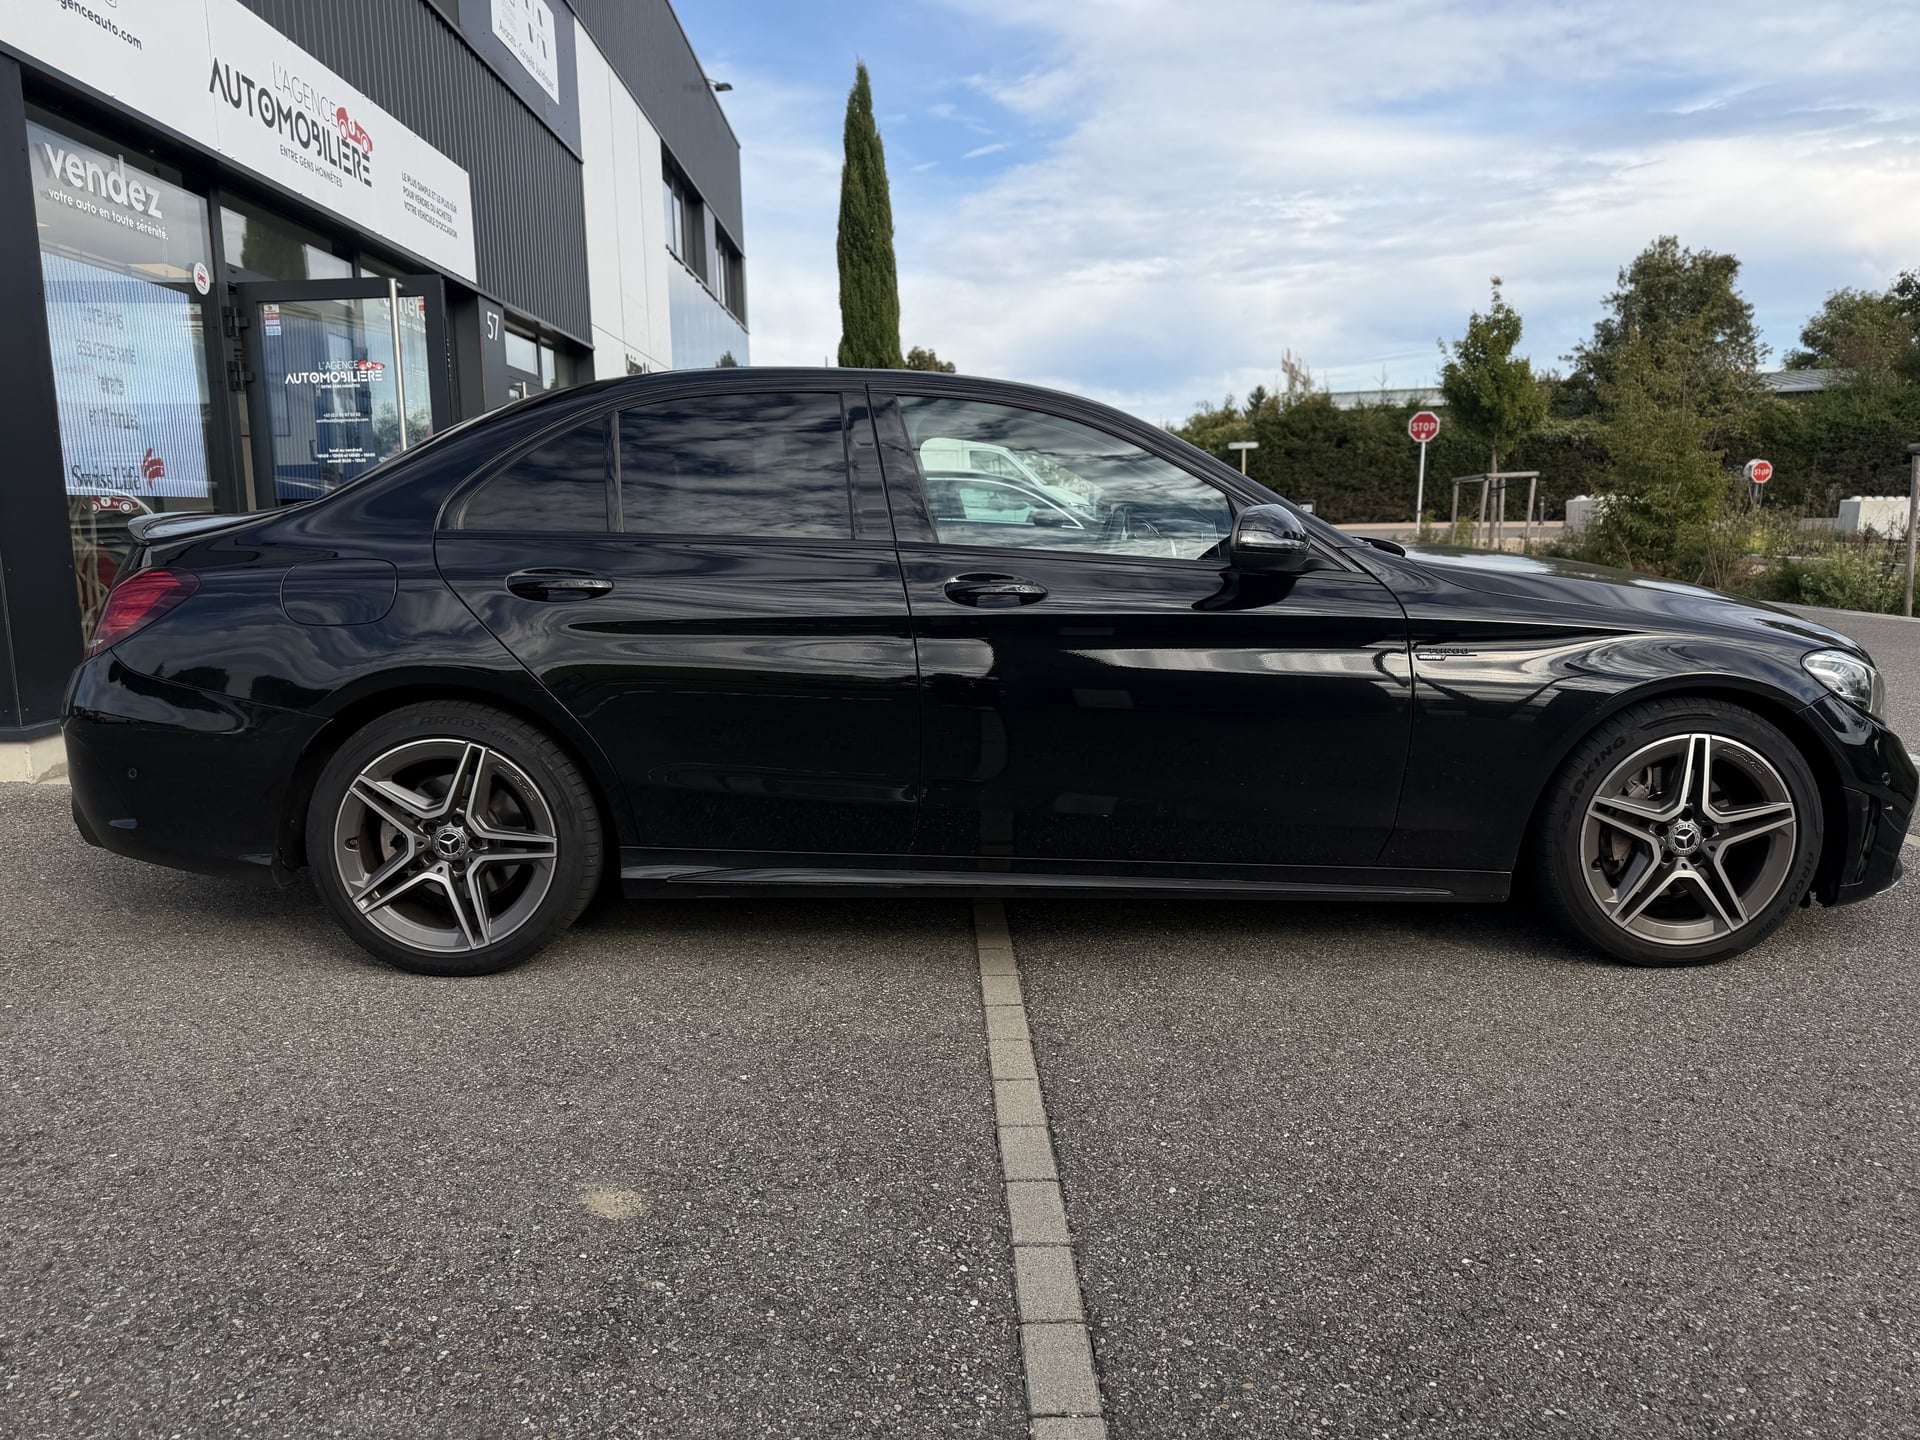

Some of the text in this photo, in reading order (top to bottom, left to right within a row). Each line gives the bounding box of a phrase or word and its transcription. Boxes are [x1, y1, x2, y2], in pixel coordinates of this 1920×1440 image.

[57, 0, 142, 50] genceauto.com
[272, 61, 338, 128] L'AGENCE
[280, 144, 298, 163] ENTRE
[299, 155, 314, 172] GENS
[44, 142, 162, 219] vendez
[48, 188, 73, 206] votre
[75, 198, 97, 214] auto
[99, 208, 110, 220] en
[112, 211, 134, 228] toute
[487, 311, 499, 341] 57
[318, 360, 358, 370] L'AGENCE
[1412, 422, 1435, 432] STOP
[1754, 468, 1770, 476] STOP
